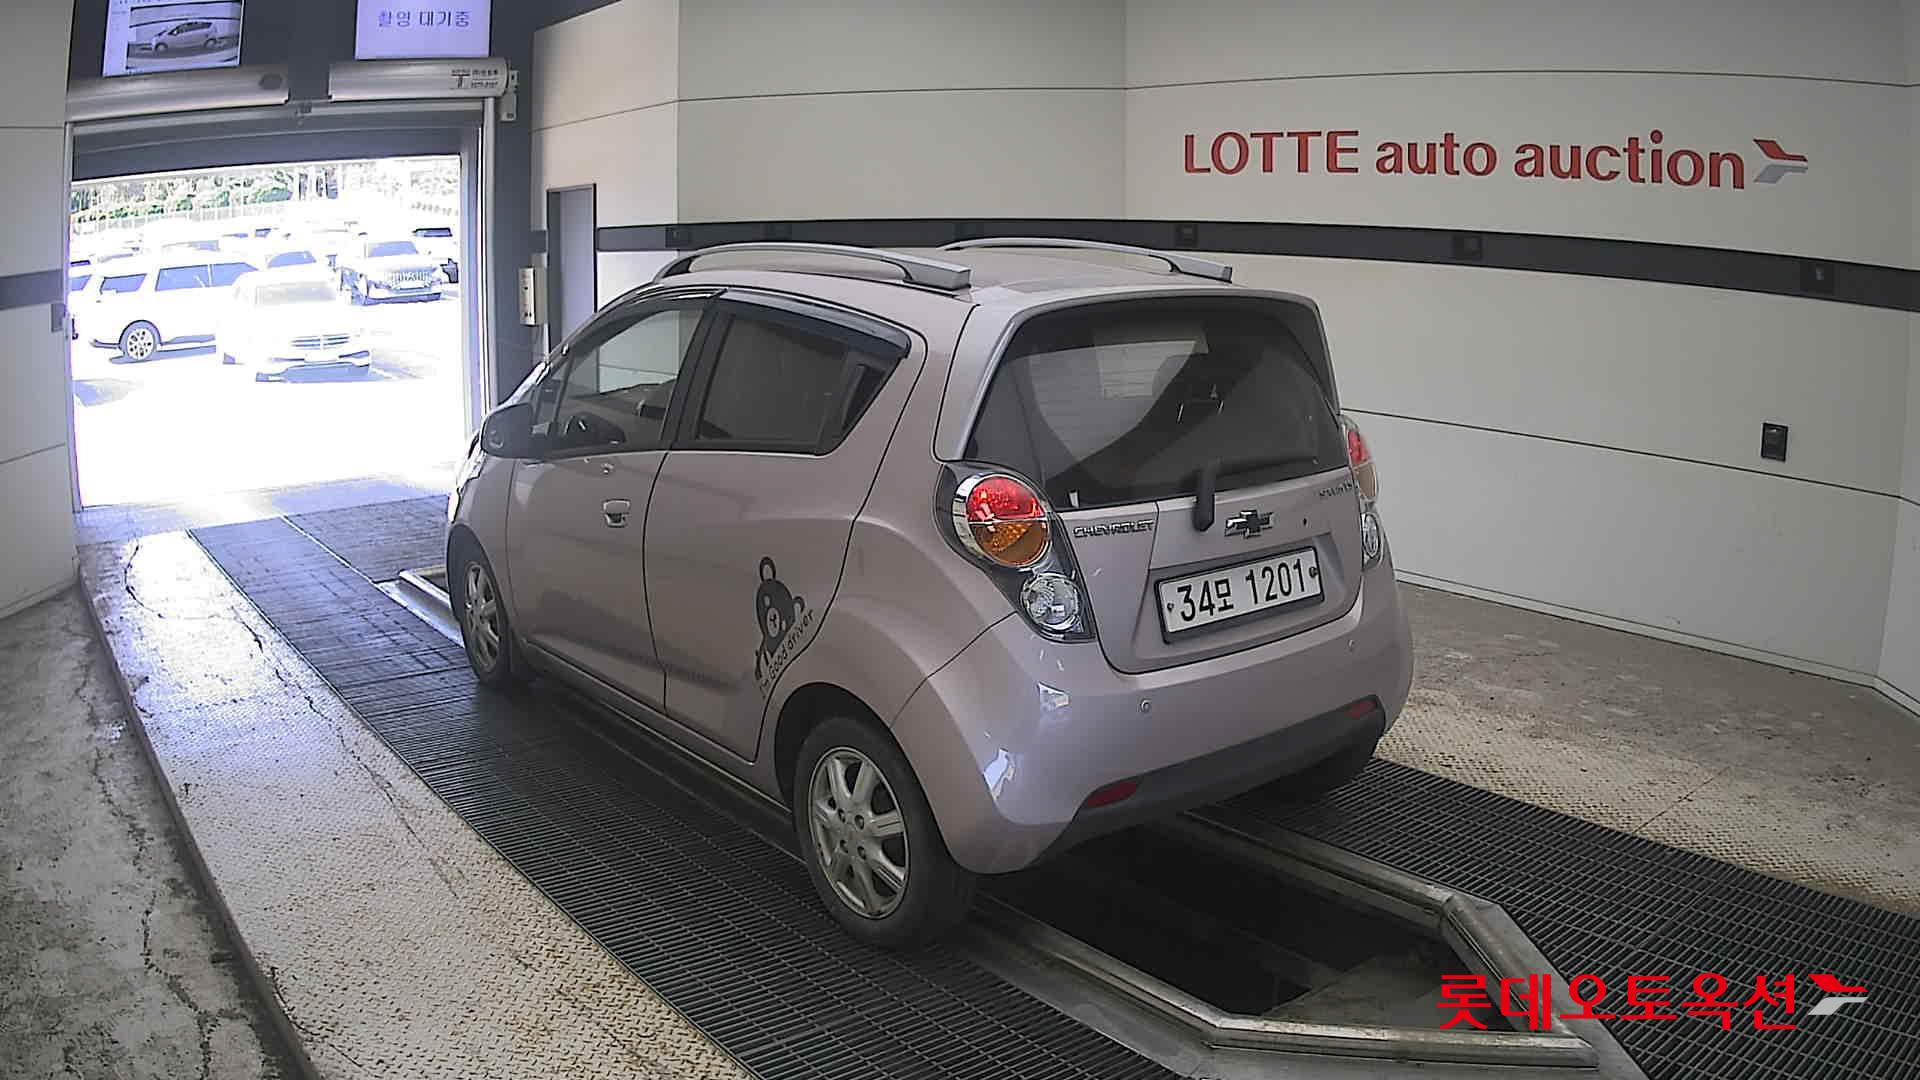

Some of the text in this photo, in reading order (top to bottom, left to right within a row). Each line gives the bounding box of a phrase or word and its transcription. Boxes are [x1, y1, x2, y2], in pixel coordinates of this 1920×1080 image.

[419, 11, 470, 27] 대기중
[1185, 130, 1745, 189] LOTTE auto auction
[1073, 519, 1154, 538] CHEVROLET
[1177, 558, 1306, 622] 34모 1201
